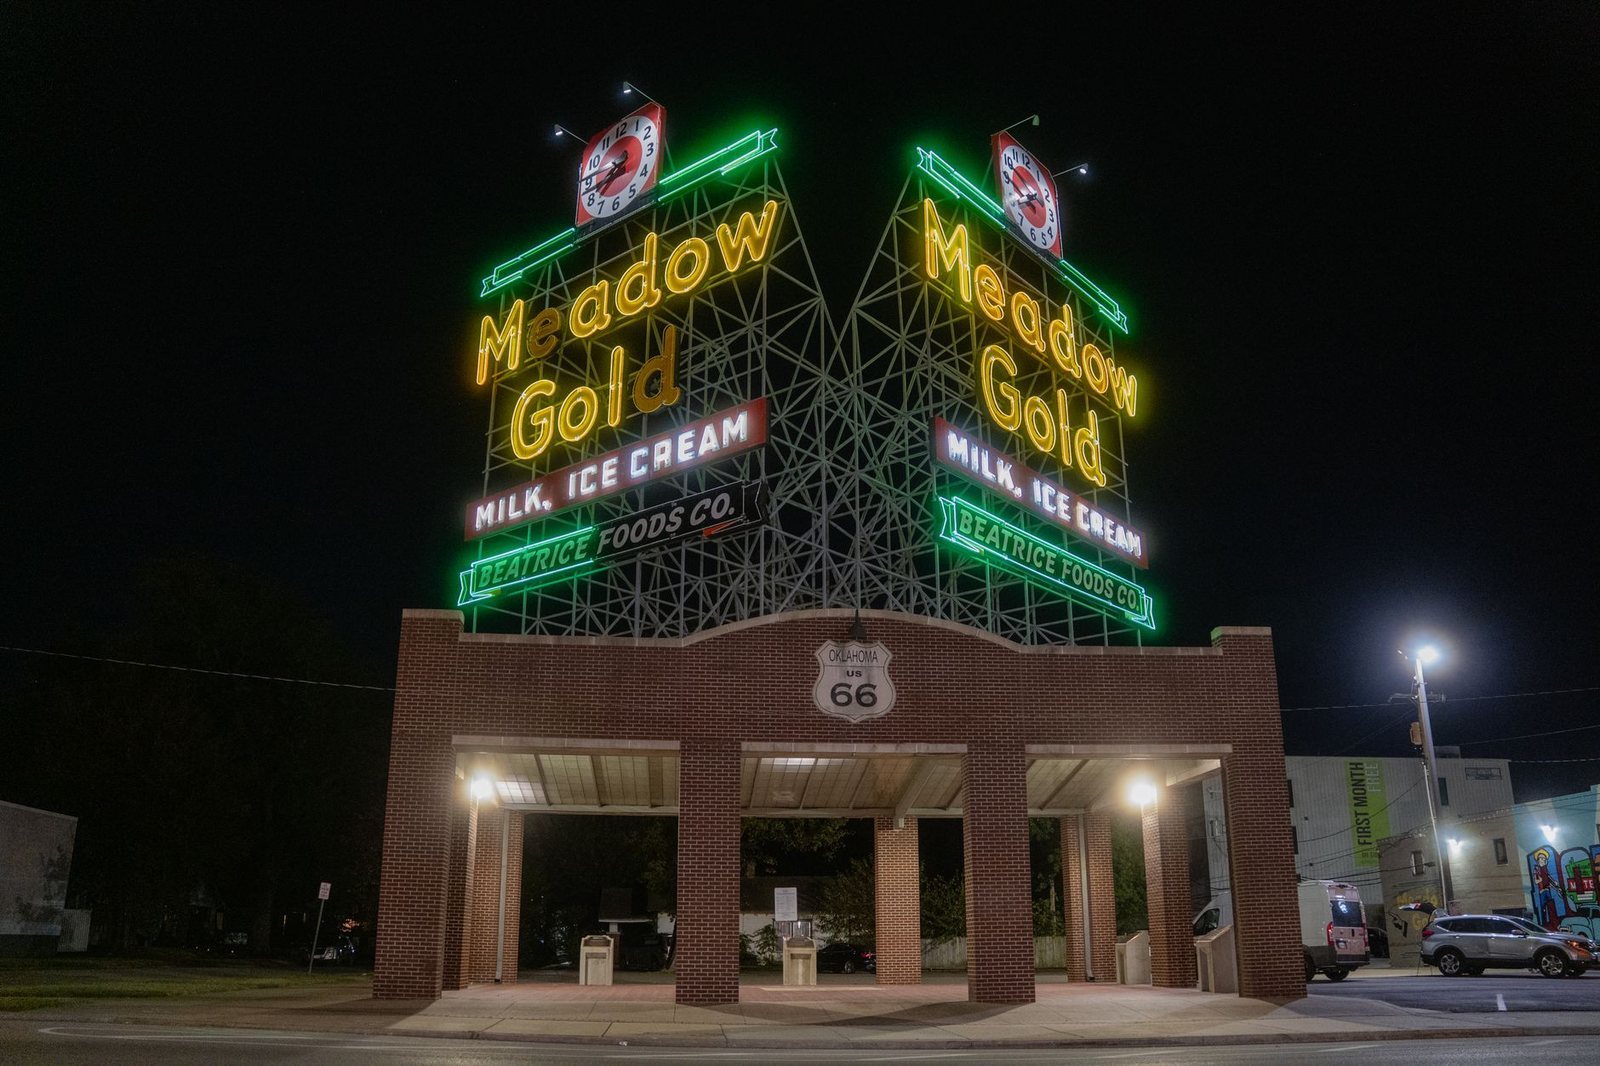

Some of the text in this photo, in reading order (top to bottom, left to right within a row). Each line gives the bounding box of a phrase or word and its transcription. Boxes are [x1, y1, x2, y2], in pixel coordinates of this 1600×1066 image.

[615, 121, 628, 138] 12
[635, 120, 639, 131] 1
[643, 125, 652, 140] 2
[602, 136, 610, 151] 11
[646, 142, 654, 157] 3
[588, 154, 600, 171] 10
[1004, 154, 1014, 170] 10
[1012, 148, 1019, 163] 11
[1021, 153, 1031, 170] 12
[640, 164, 649, 178] 4
[1003, 170, 1010, 185] 9
[584, 177, 593, 191] 9
[628, 184, 637, 199] 5
[587, 192, 596, 207] 8
[1044, 188, 1051, 203] 2
[597, 200, 605, 215] 7
[612, 196, 620, 211] 6
[1017, 212, 1024, 226] 7
[1048, 208, 1054, 223] 3
[1030, 228, 1037, 242] 6
[1041, 233, 1047, 246] 5
[1047, 226, 1053, 240] 4
[476, 200, 778, 385] Meadow
[924, 197, 1138, 417] Meadow
[510, 323, 681, 460] Gold
[980, 344, 1107, 488] Gold
[475, 410, 748, 532] MILK, ICE CREAM
[947, 430, 1142, 559] MILK, ICE CREAM
[478, 493, 735, 588] BEATRICE FOODS CO.
[959, 508, 1140, 611] BEATRICE FOODS CO.
[829, 648, 878, 663] OKLAHOMA
[846, 670, 862, 678] US
[830, 682, 878, 708] 66
[1349, 762, 1368, 808] MONTH
[1354, 810, 1372, 846] FIRST
